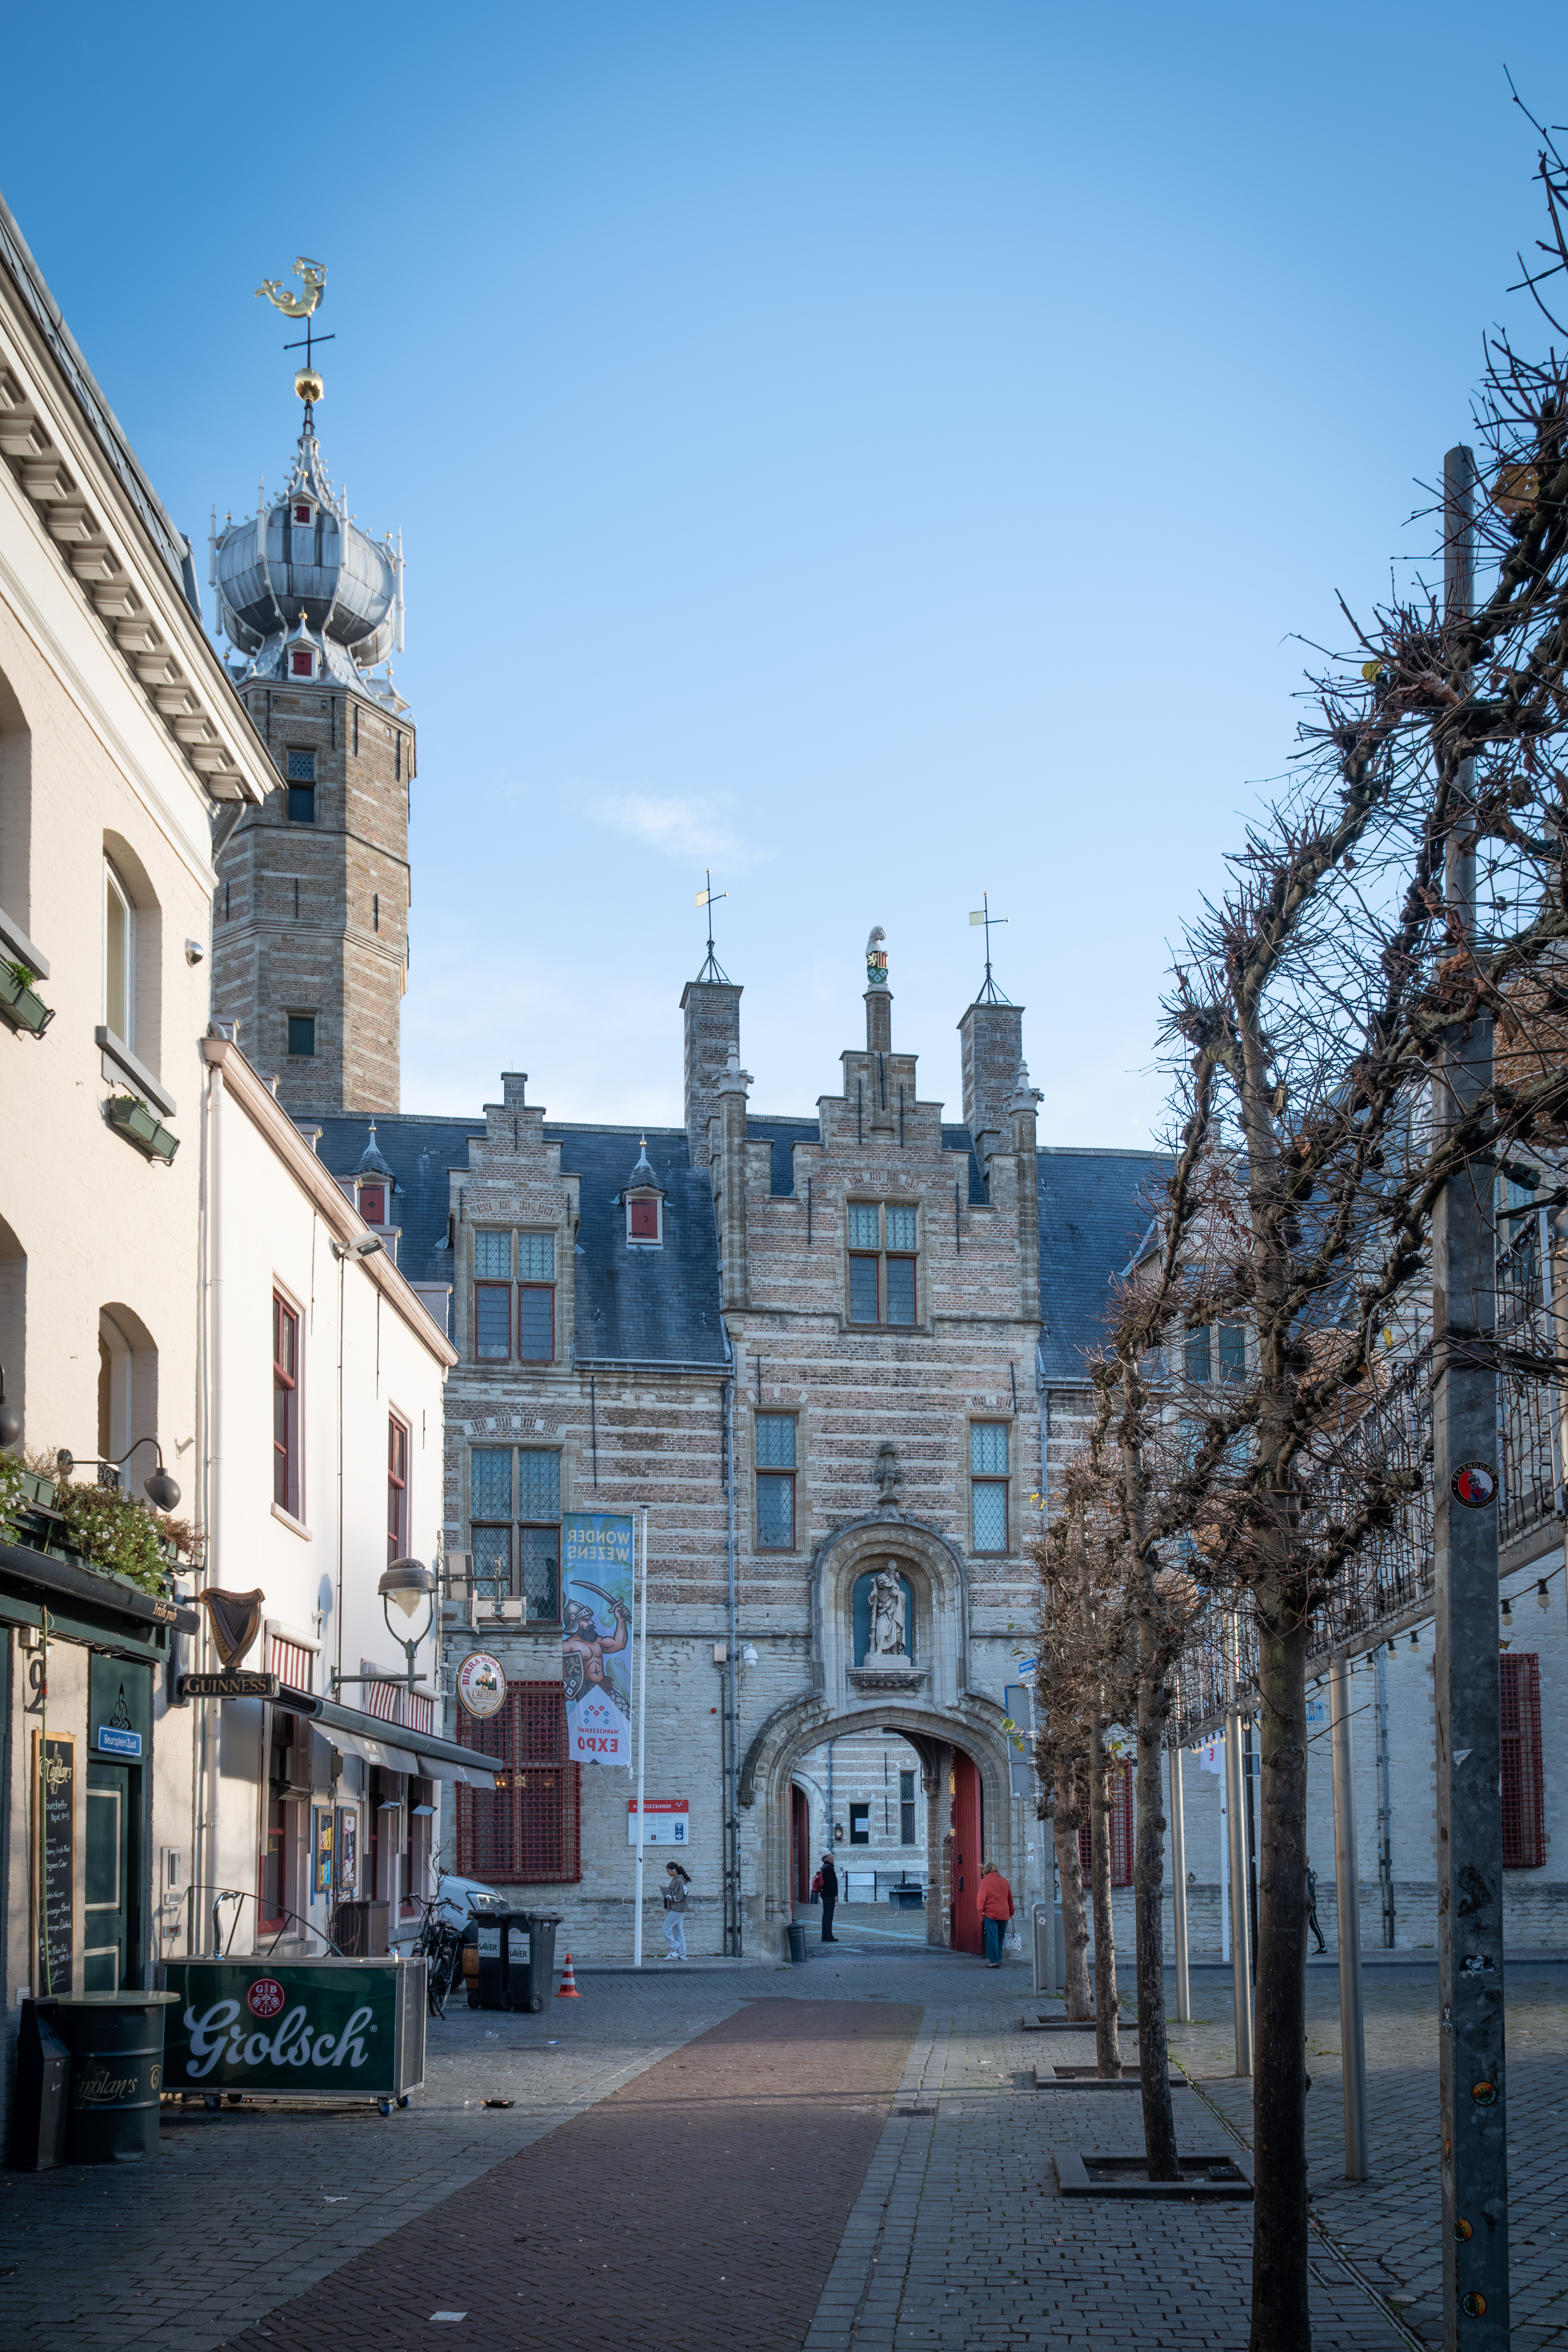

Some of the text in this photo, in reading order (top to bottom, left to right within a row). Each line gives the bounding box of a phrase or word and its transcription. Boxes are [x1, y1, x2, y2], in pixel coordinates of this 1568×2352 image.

[1452, 1463, 1495, 1481] FEYENOORD
[153, 1602, 177, 1623] Irish pub
[462, 1657, 504, 1688] BIRRA MORETTI
[186, 1677, 267, 1693] GUINNESS
[472, 1690, 499, 1699] L'AUTENTICA
[104, 1734, 136, 1749] Beursplein Zuid
[479, 1939, 497, 1951] SAVER
[509, 1945, 528, 1958] SAVER
[183, 1999, 372, 2077] Grolsch
